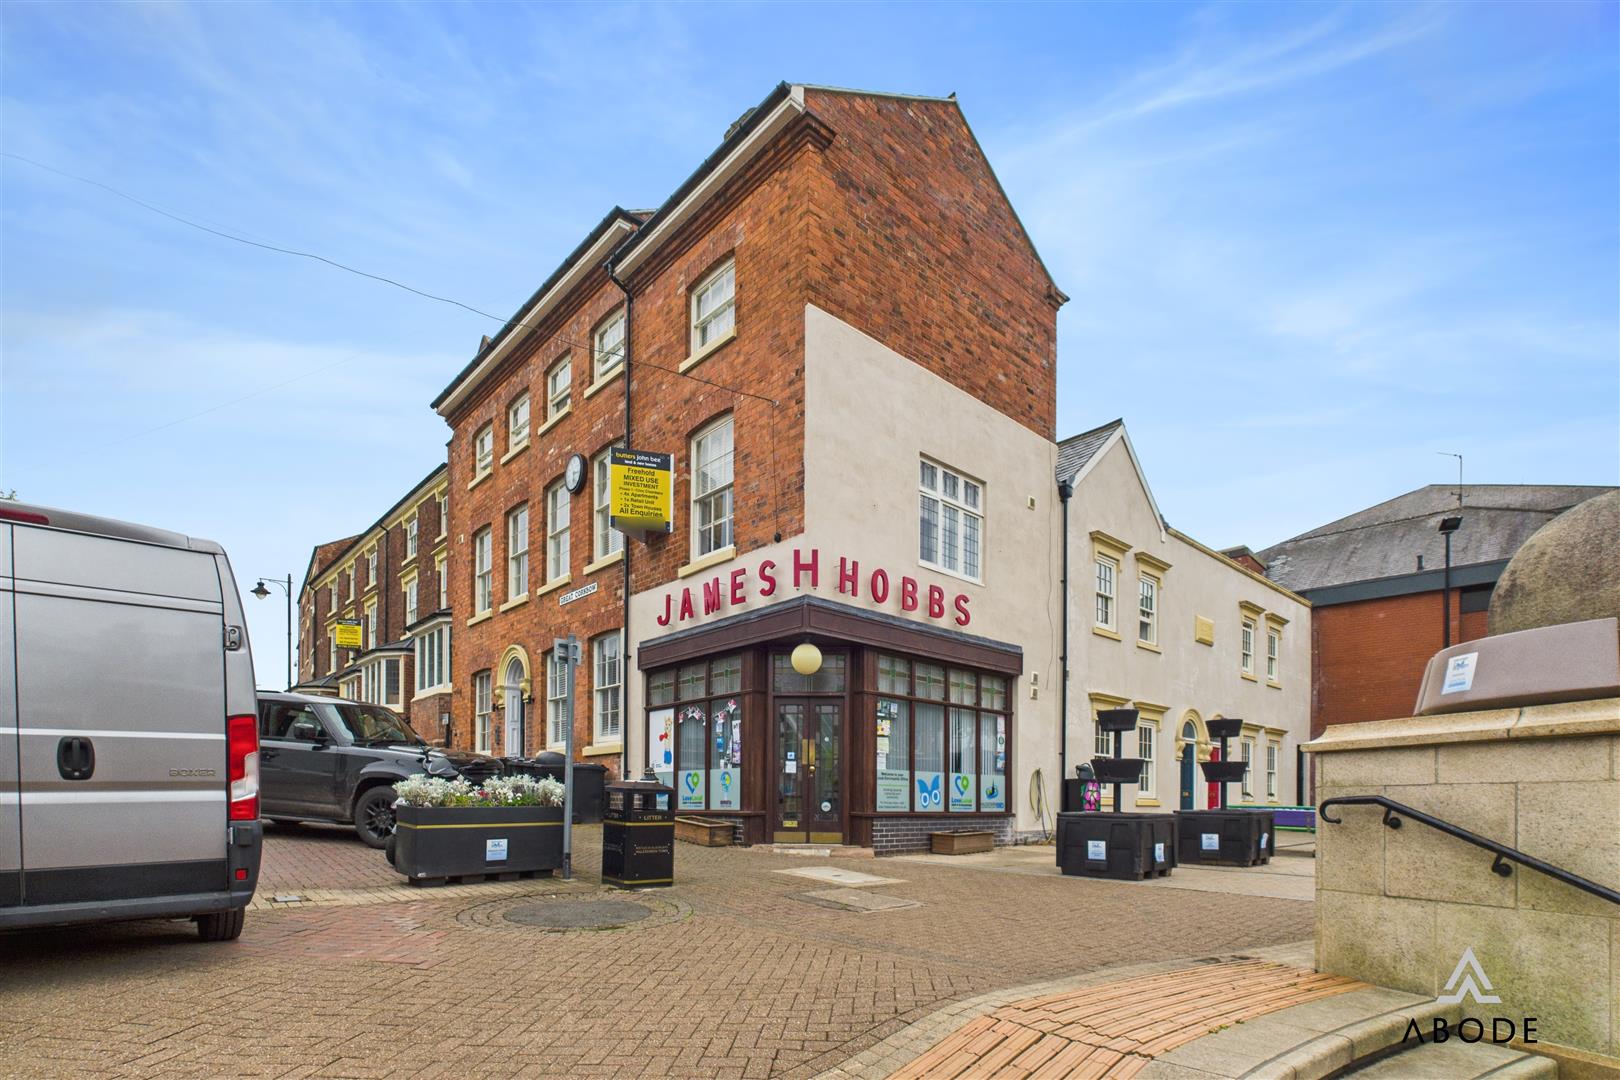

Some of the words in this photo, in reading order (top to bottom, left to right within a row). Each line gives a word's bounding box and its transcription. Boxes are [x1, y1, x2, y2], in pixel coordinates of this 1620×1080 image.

[627, 467, 655, 476] Freehold
[624, 481, 659, 490] INVESTMENT
[631, 492, 659, 500] Apartments
[630, 508, 663, 517] Enquiries
[657, 559, 776, 627] JAMES
[793, 549, 819, 588] H
[839, 556, 971, 627] HOBBS
[168, 768, 217, 777] BOXER
